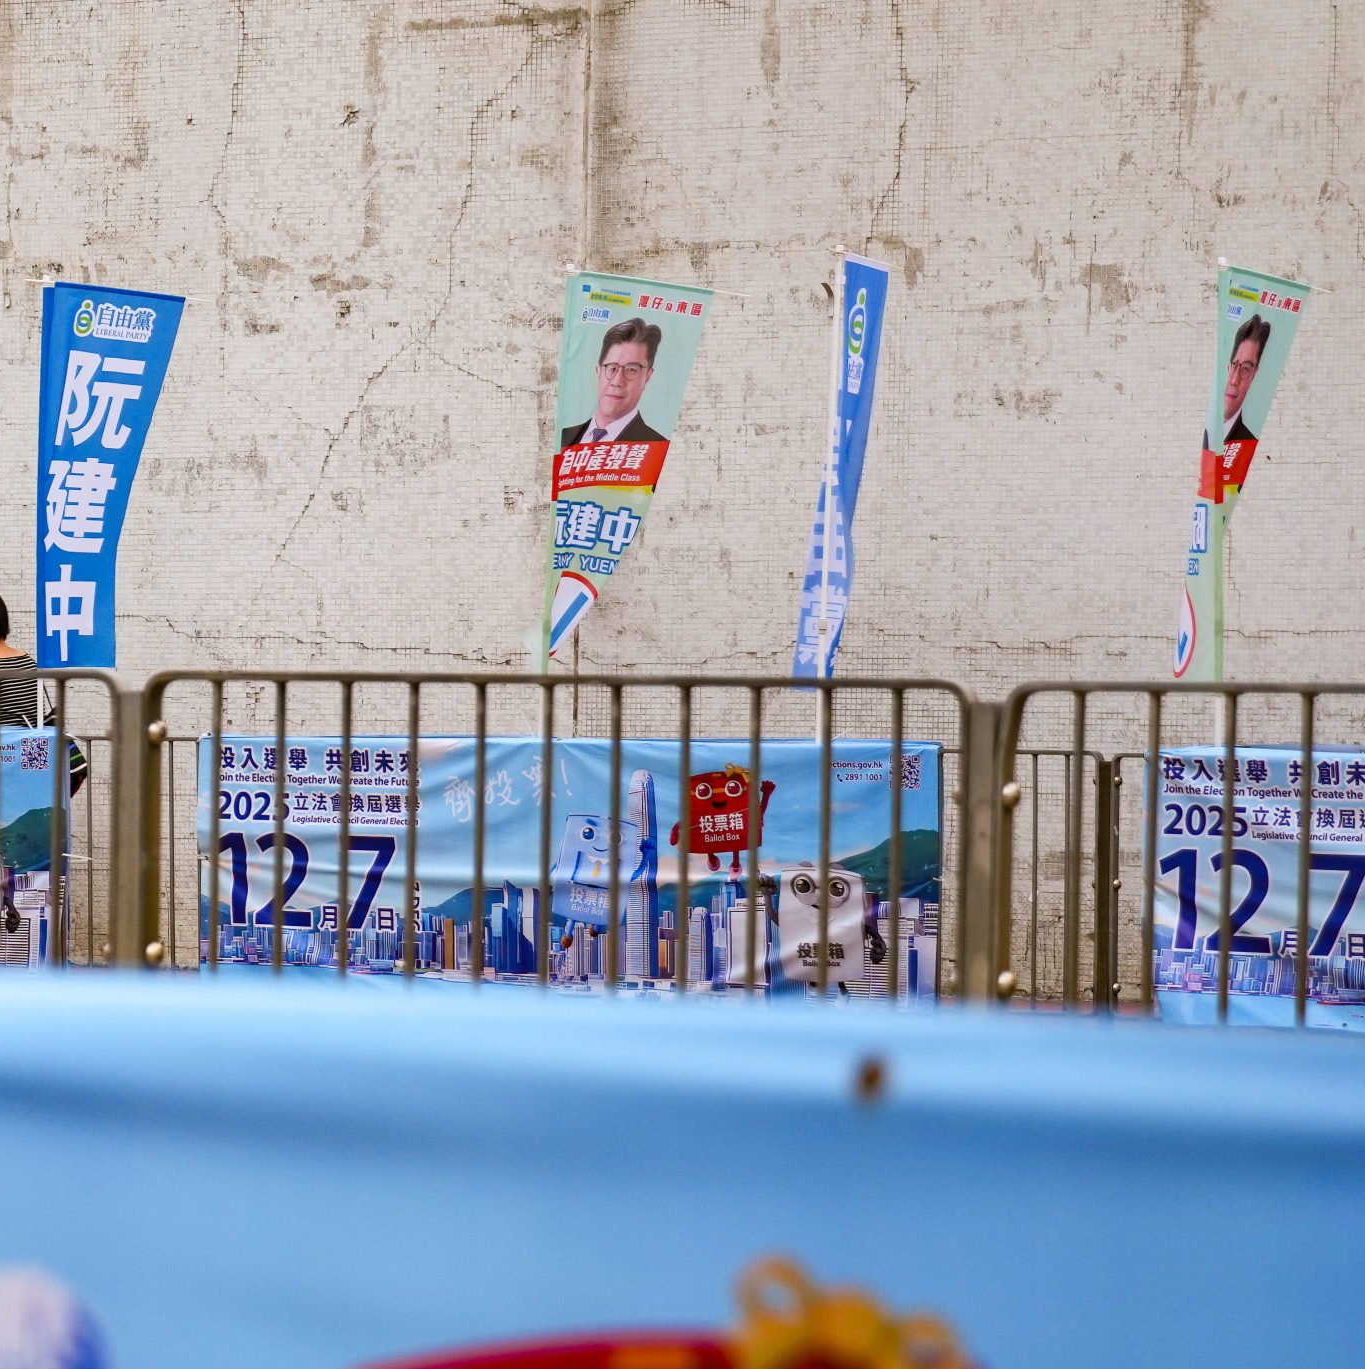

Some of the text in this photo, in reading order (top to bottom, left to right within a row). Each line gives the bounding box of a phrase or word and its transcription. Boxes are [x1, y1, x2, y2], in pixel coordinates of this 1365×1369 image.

[98, 306, 153, 331] 自由黨
[96, 328, 149, 341] LIBERAL PARTY
[585, 475, 594, 483] the
[595, 473, 618, 482] Middle
[621, 474, 640, 482] Class
[45, 350, 146, 662] 阮建中
[235, 774, 388, 787] the Together We the
[1164, 784, 1363, 800] Join the Together Create the
[292, 815, 388, 825] Legislative General
[699, 812, 744, 833] 投票箱
[704, 832, 740, 844] Ballot Box
[1252, 831, 1362, 842] Legislative General
[218, 831, 397, 932] 12月7日
